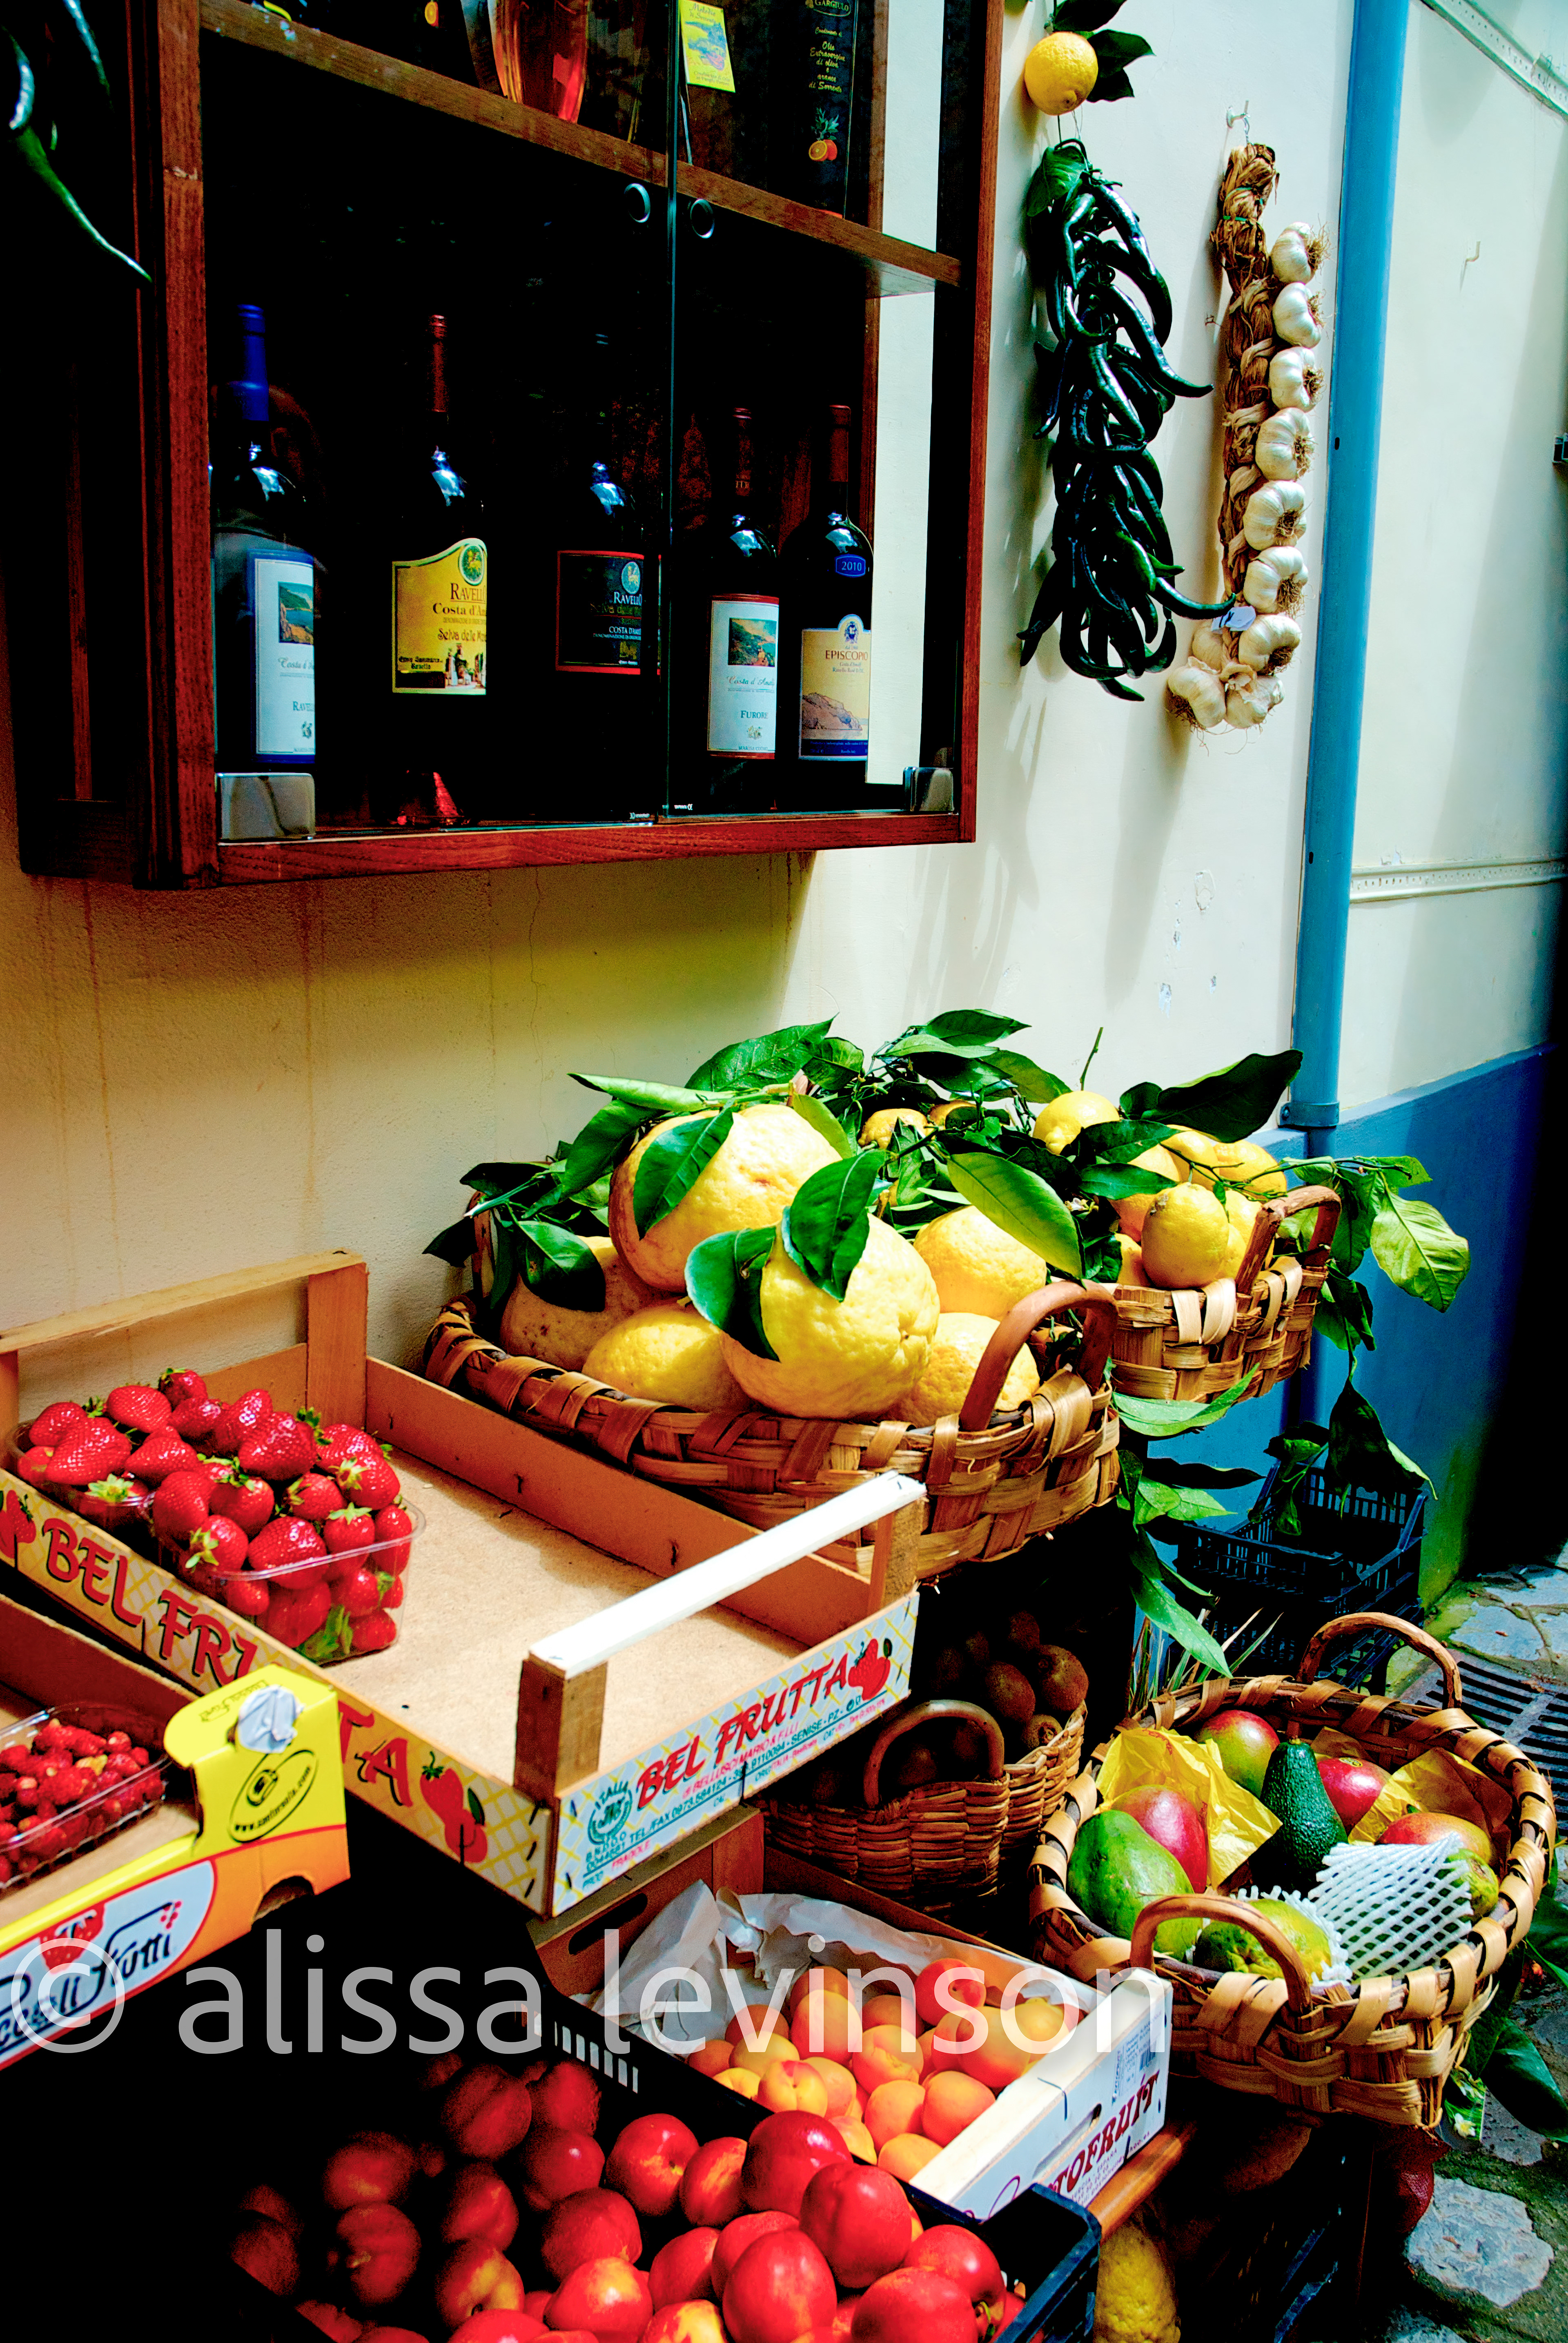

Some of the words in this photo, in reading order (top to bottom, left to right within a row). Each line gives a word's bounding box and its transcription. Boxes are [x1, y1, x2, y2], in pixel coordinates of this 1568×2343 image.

[842, 561, 862, 571] 2010
[613, 591, 642, 606] RAVELLO
[433, 603, 466, 615] Costa
[826, 650, 868, 660] EPISCOPIO
[726, 676, 749, 685] Costa
[740, 710, 768, 719] FURORE
[42, 1518, 143, 1627] BEL
[636, 1735, 706, 1811] BEL
[715, 1653, 848, 1767] FRUTTA
